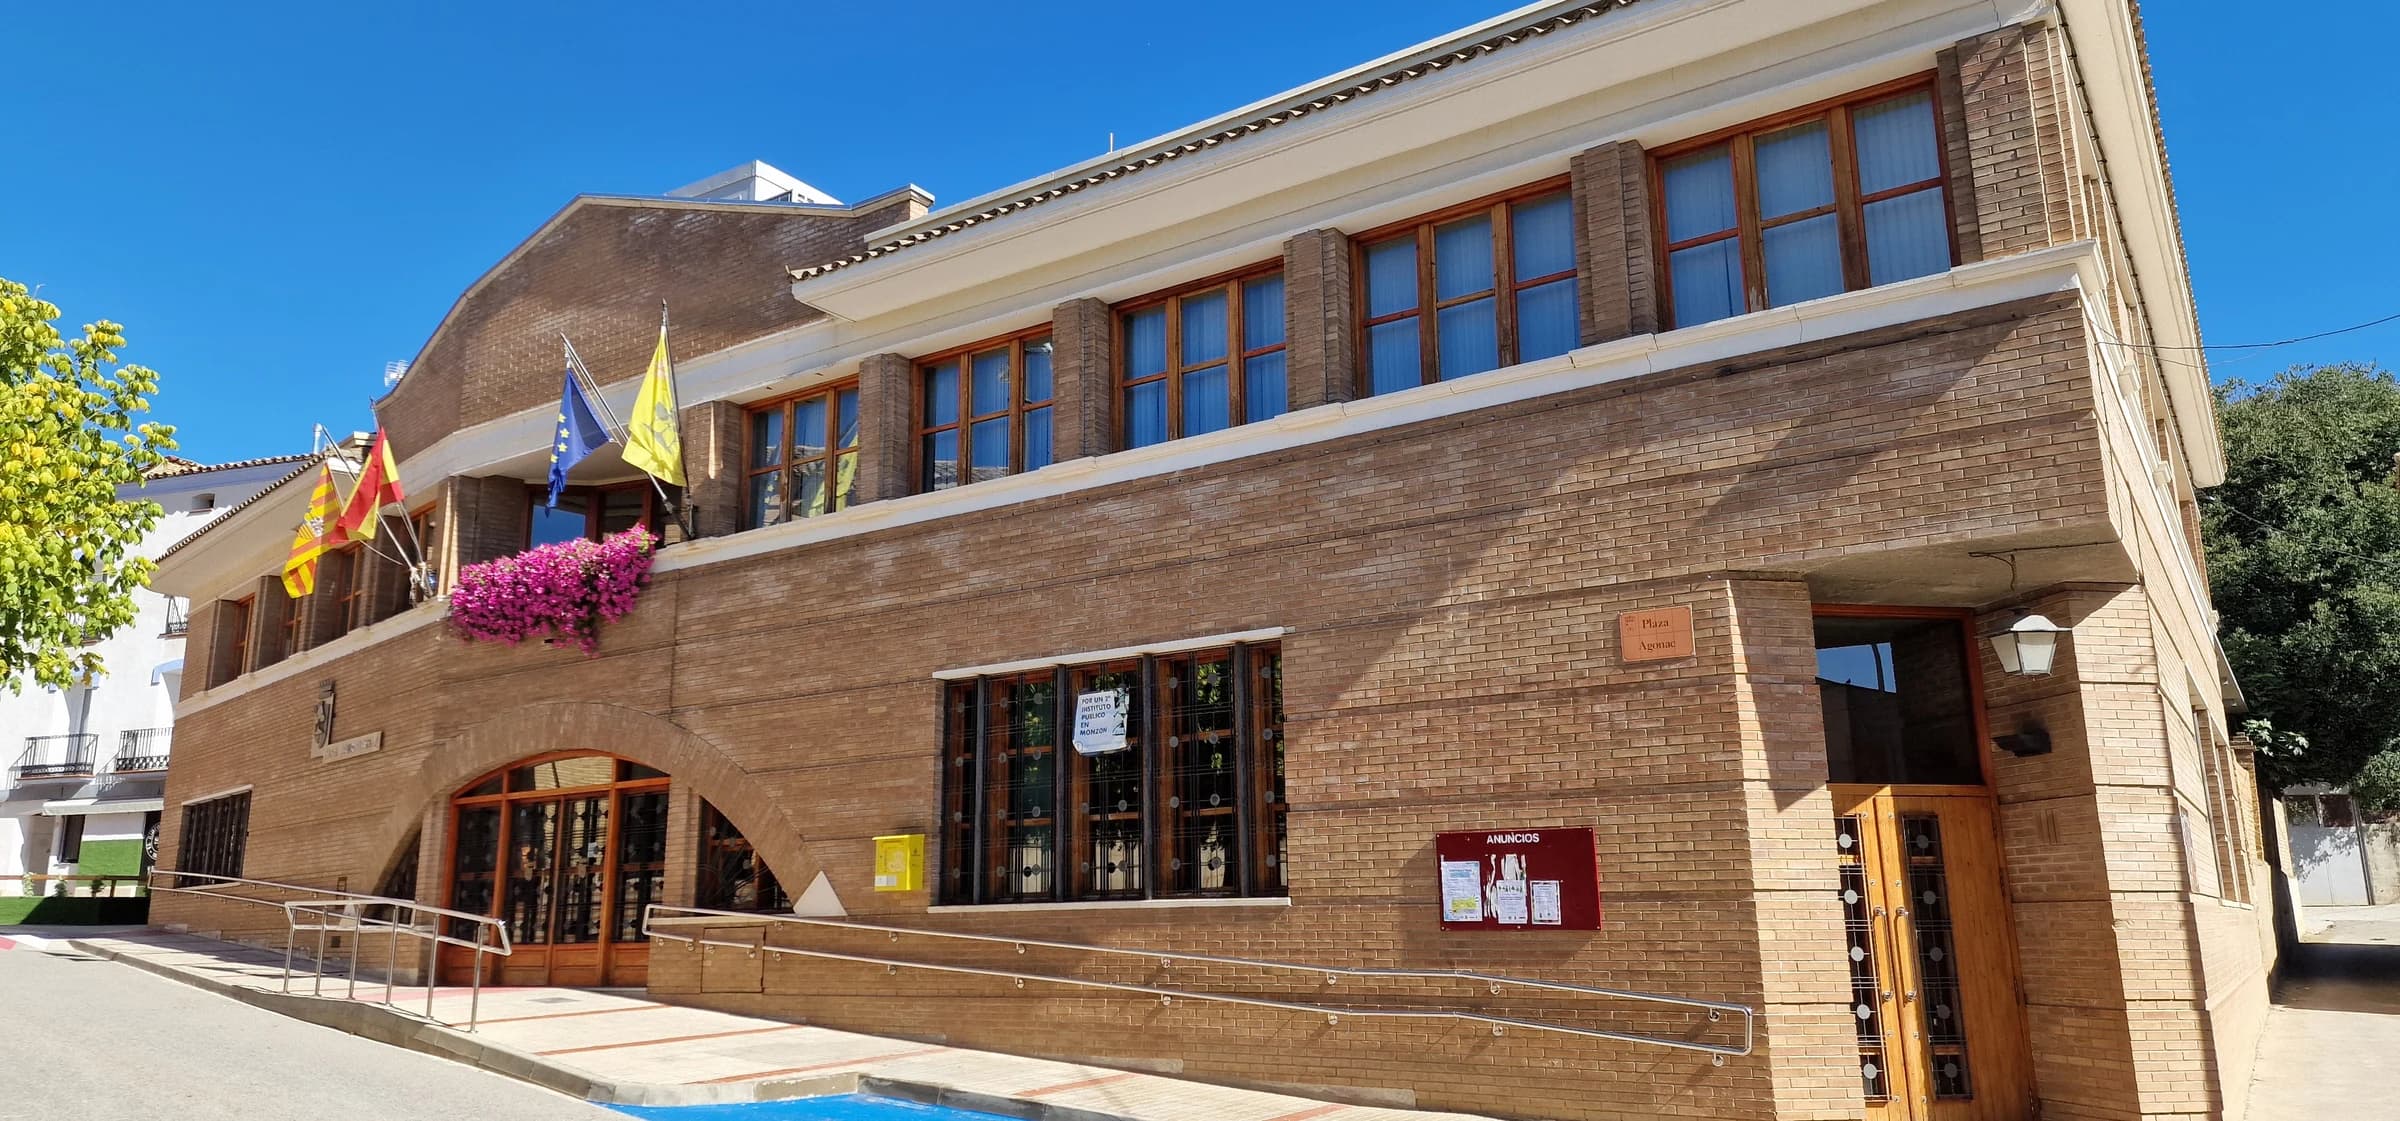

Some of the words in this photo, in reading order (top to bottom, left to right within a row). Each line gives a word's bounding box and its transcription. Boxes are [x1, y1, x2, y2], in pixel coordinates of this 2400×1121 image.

[1642, 618, 1669, 629] Plaza
[1640, 640, 1676, 651] Agonac
[1081, 704, 1111, 712] INSTITUTO
[1486, 832, 1540, 844] ANUNCIOS
